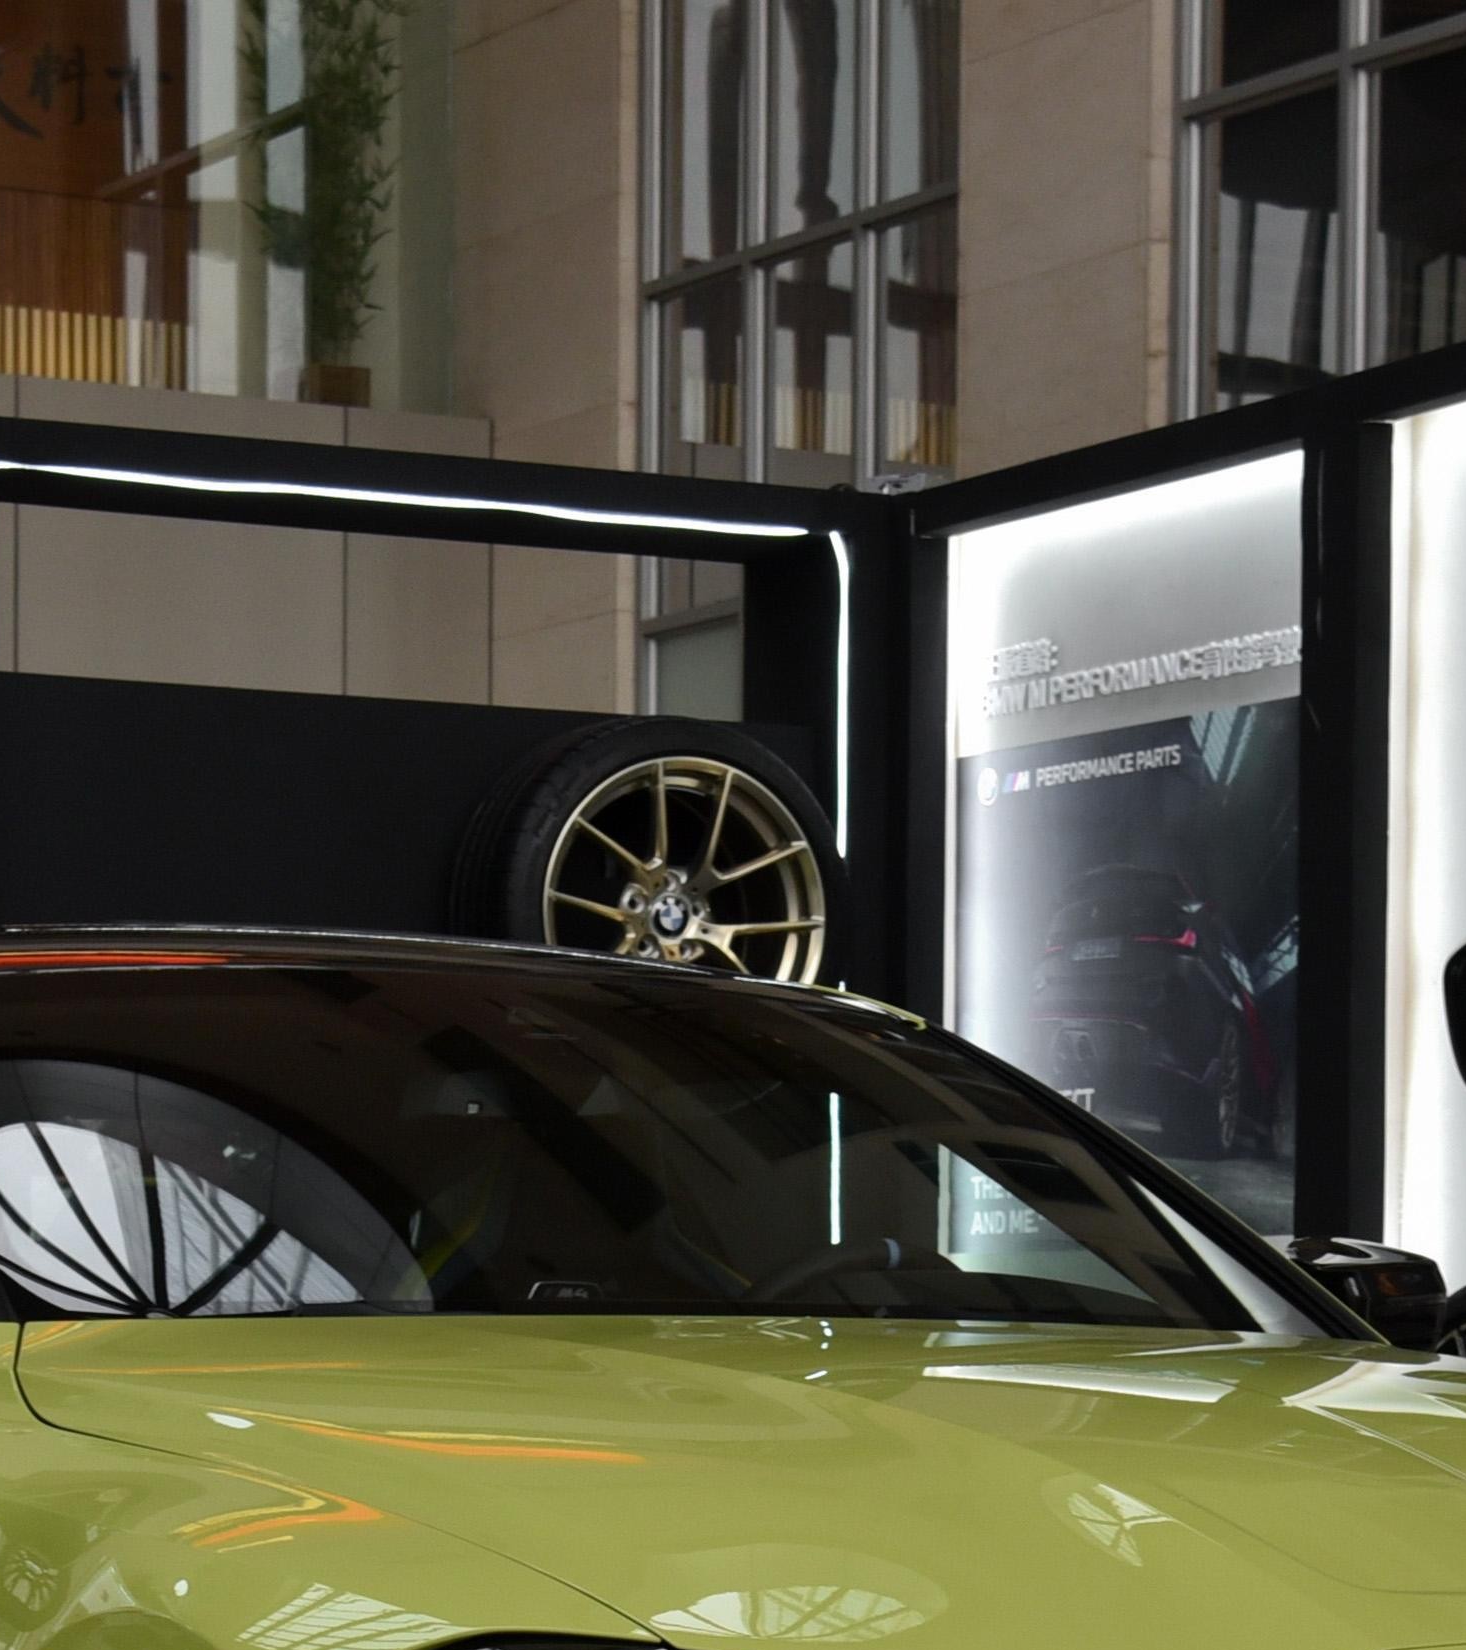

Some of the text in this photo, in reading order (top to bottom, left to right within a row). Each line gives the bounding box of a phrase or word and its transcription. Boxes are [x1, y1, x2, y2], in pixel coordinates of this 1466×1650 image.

[1036, 754, 1133, 787] PERFORMANCE
[1136, 744, 1181, 771] PARTS
[970, 1211, 1006, 1235] AND
